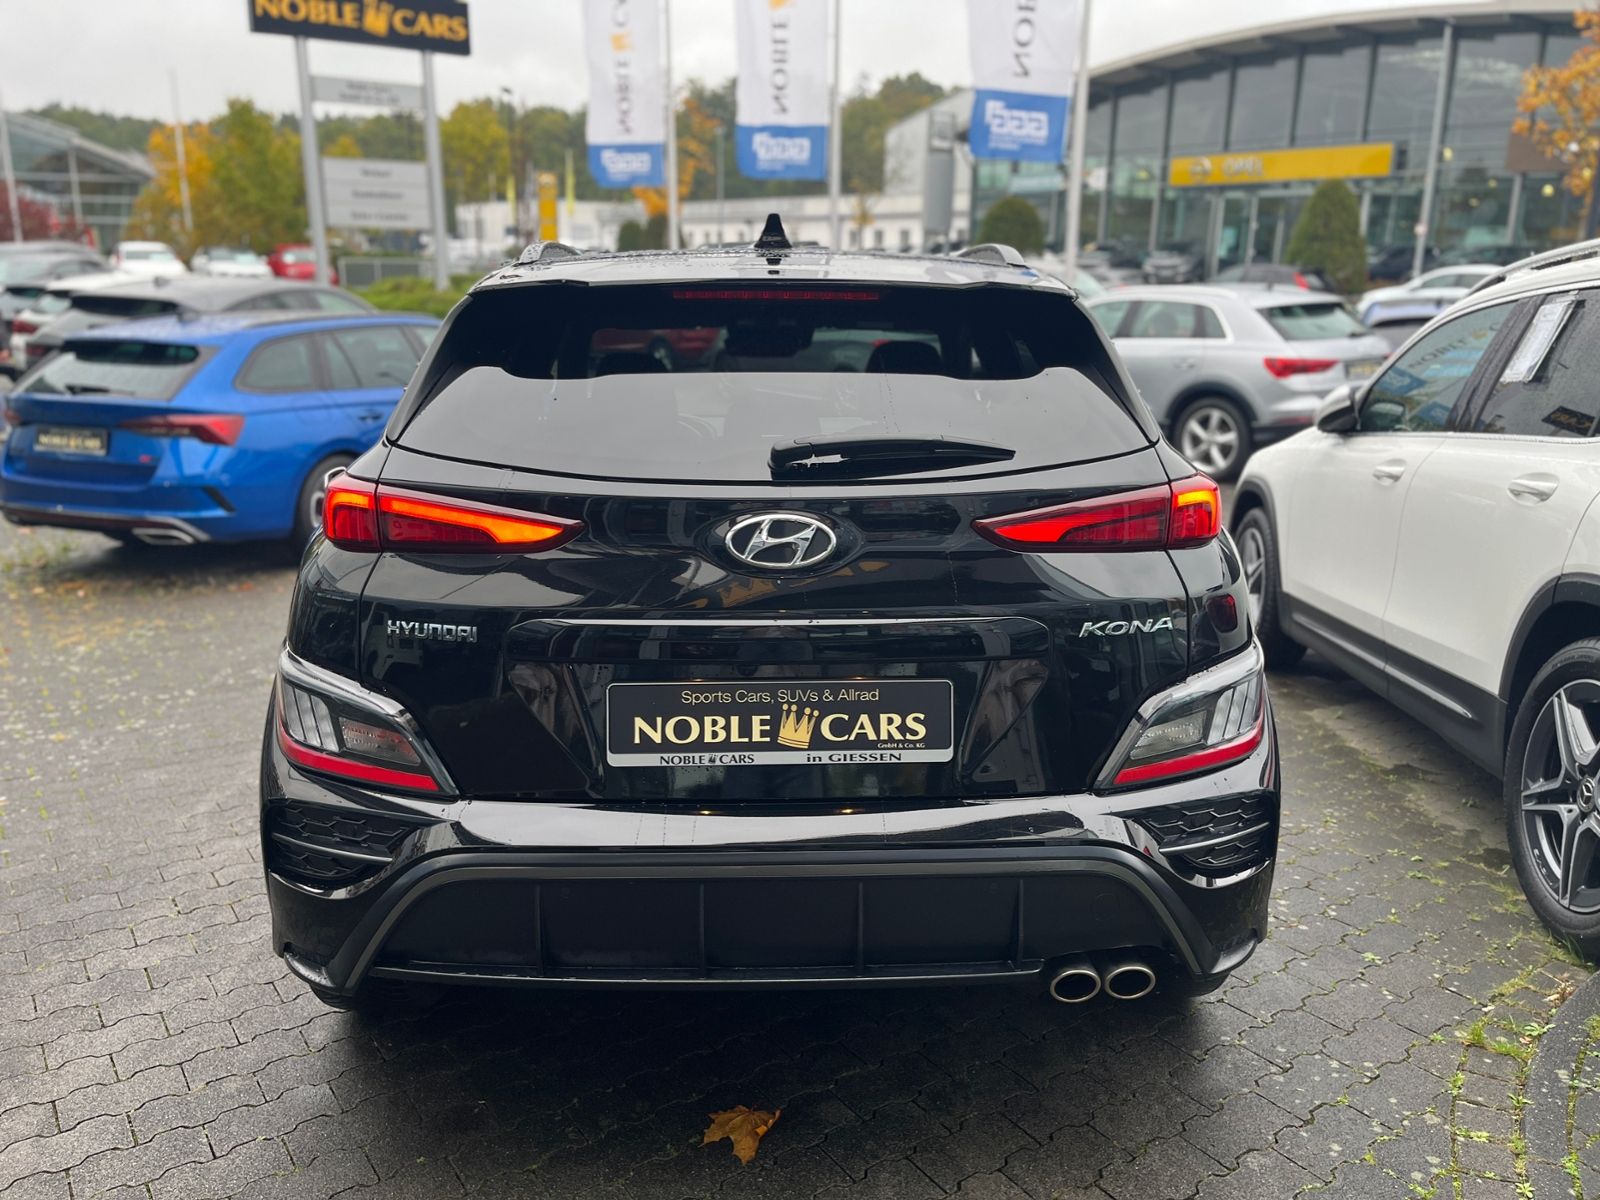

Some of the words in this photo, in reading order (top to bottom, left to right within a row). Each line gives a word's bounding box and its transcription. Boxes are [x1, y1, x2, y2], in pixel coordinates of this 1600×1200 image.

[254, 0, 361, 28] NOBLE
[392, 9, 468, 41] CARS
[387, 620, 478, 643] HYUNDAI
[1078, 617, 1174, 638] KONA
[681, 690, 732, 705] Sports
[735, 689, 774, 704] Cars,
[777, 688, 819, 702] SUVs
[822, 689, 835, 702] &
[837, 688, 880, 701] Allrad
[633, 715, 771, 745] NOBLE
[820, 712, 927, 742] CARS
[659, 754, 705, 765] NOBLE
[719, 754, 755, 764] CARS
[806, 753, 823, 763] in
[831, 753, 902, 763] GIESSEN
